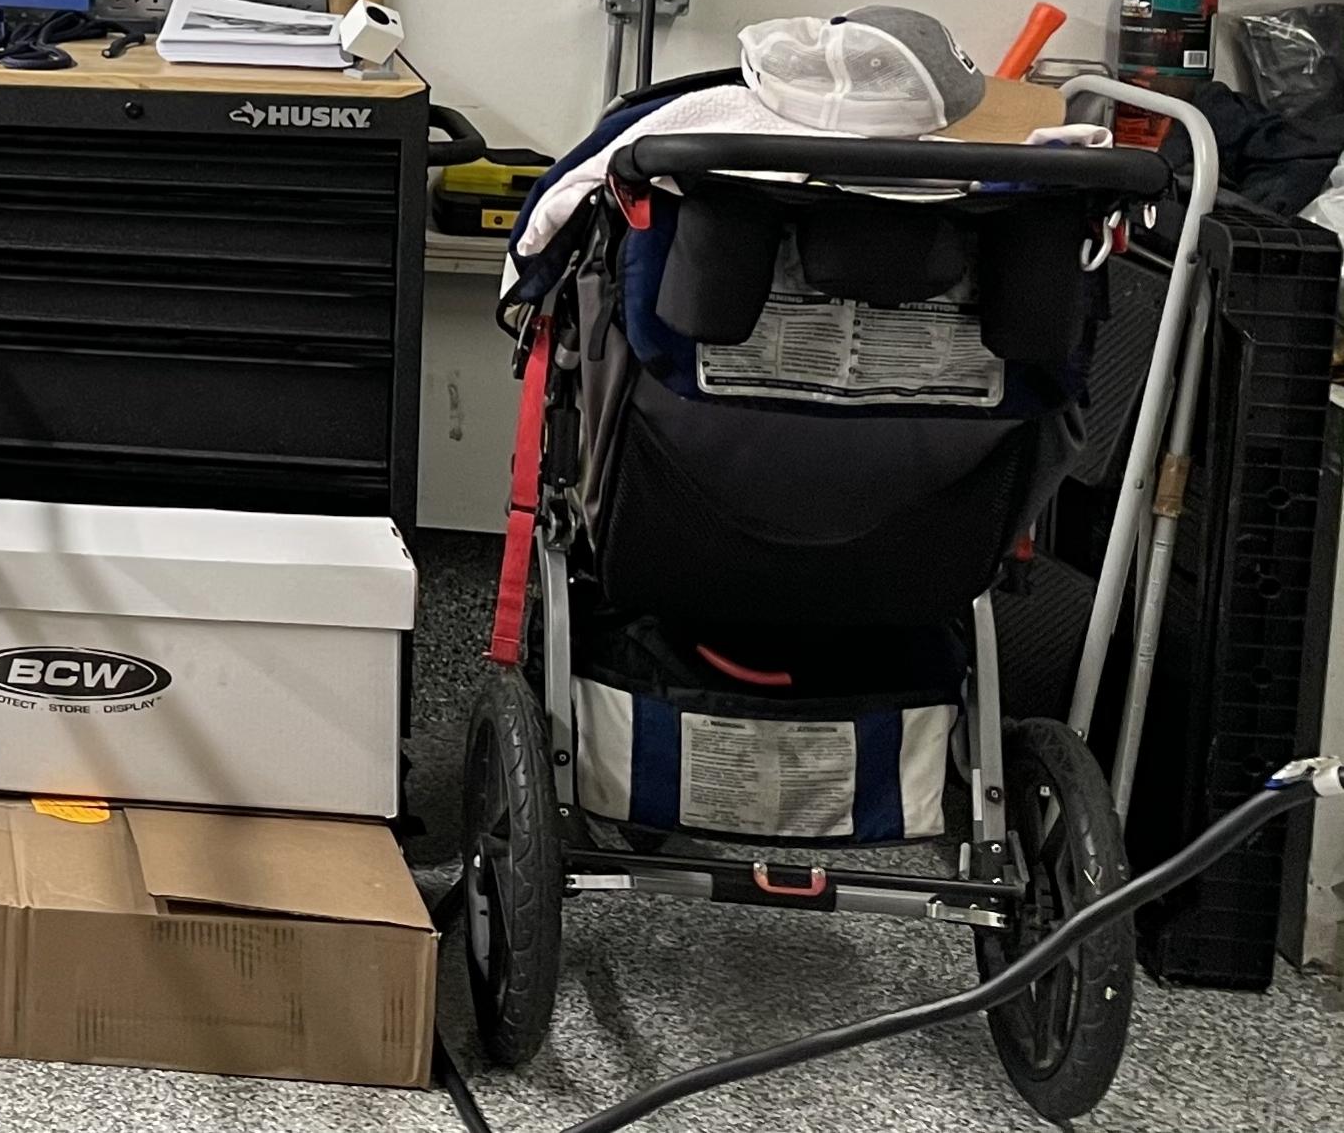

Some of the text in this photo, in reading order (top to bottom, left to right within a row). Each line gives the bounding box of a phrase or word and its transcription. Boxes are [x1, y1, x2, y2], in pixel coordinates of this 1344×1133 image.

[268, 106, 371, 129] HUSKY
[7, 657, 129, 689] BCW
[49, 703, 91, 714] STORE
[103, 698, 156, 714] DISPLAY
